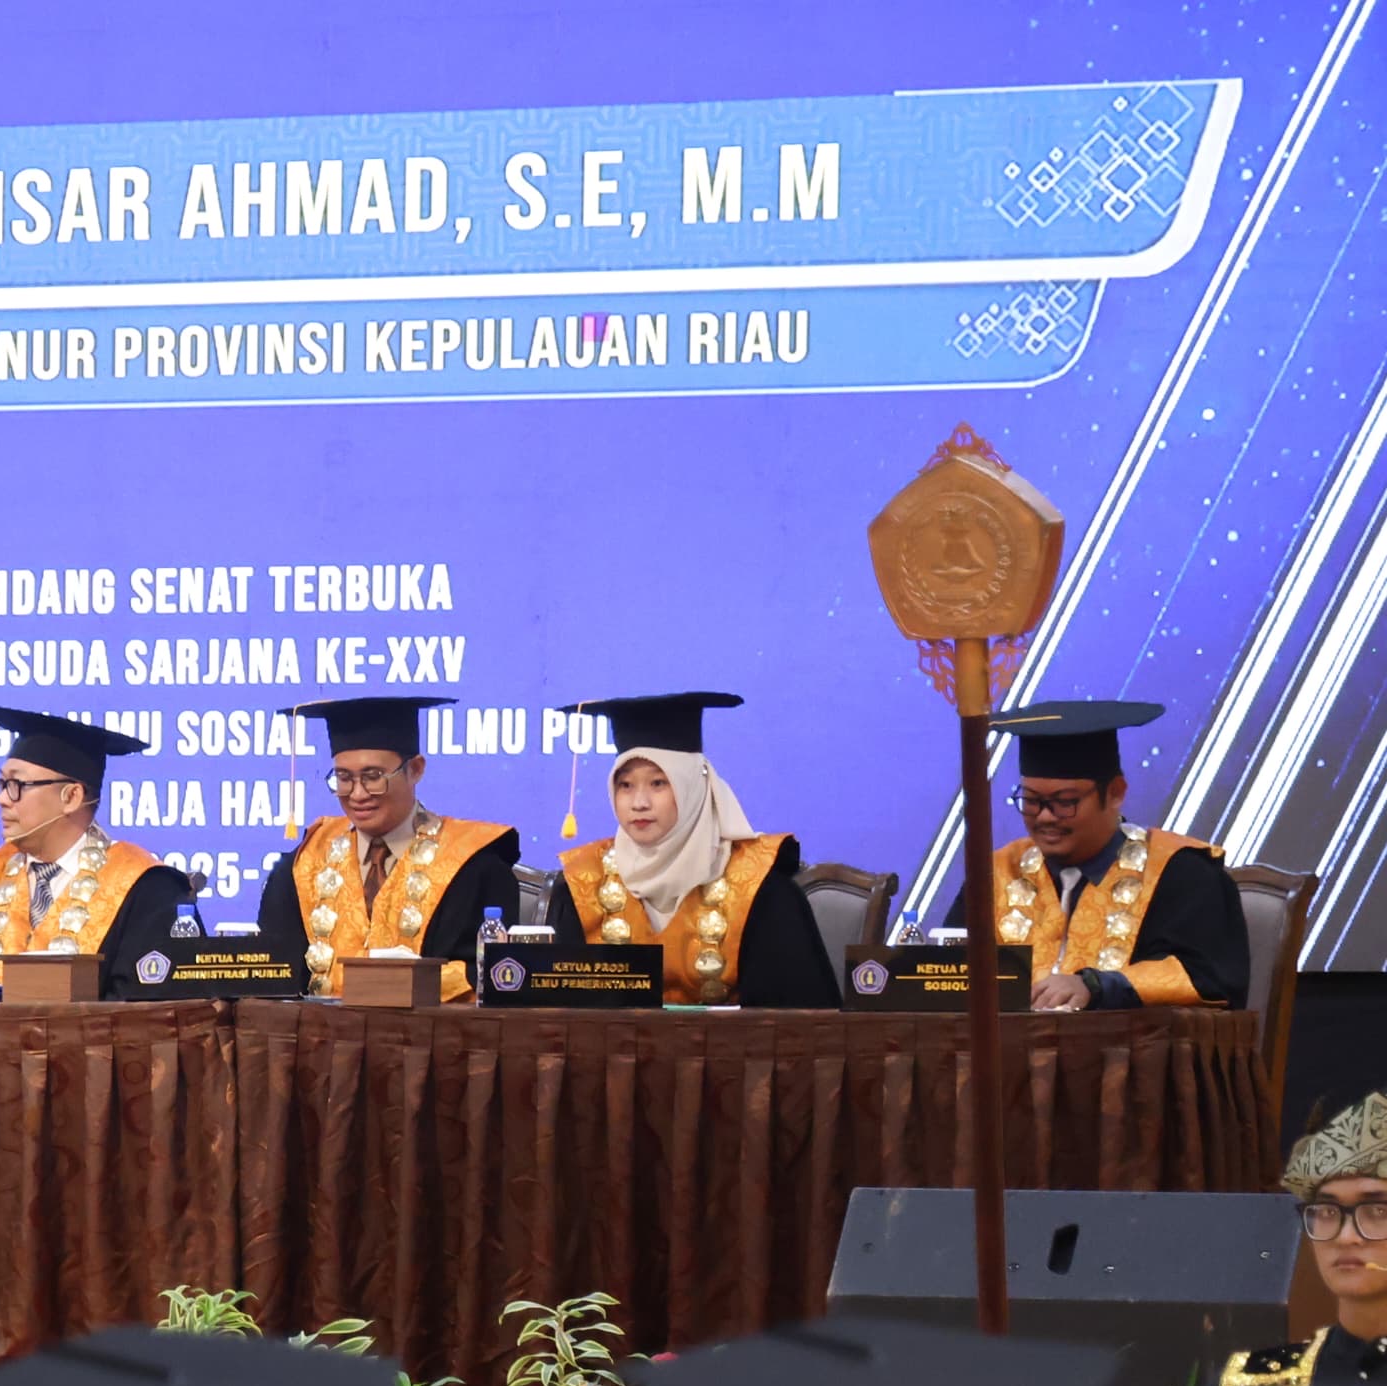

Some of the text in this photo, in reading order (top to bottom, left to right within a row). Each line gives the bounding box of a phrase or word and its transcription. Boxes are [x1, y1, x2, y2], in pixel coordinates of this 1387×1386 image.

[178, 156, 472, 245] AHMAD,
[503, 149, 648, 240] S.E,
[681, 142, 841, 225] M.M
[113, 320, 347, 378] PROVINSI
[364, 312, 669, 373] KEPULAUAN
[687, 309, 811, 365] RIAU
[129, 565, 255, 614] SENAT
[267, 562, 454, 613] TERBUKA
[123, 637, 301, 687] SARJANA
[314, 635, 466, 685] KE-XXV
[176, 708, 316, 757] SOSIAL
[427, 707, 526, 755] ILMU
[109, 779, 306, 828] RAJA HAJI
[172, 968, 292, 980] ADMINISTRASI PUBLIK
[195, 953, 270, 964] KETUA PRODI
[552, 962, 630, 973] KETUA PRODI
[916, 963, 958, 974] KETUA
[530, 978, 651, 990] ILMU PEMERINTAHAN
